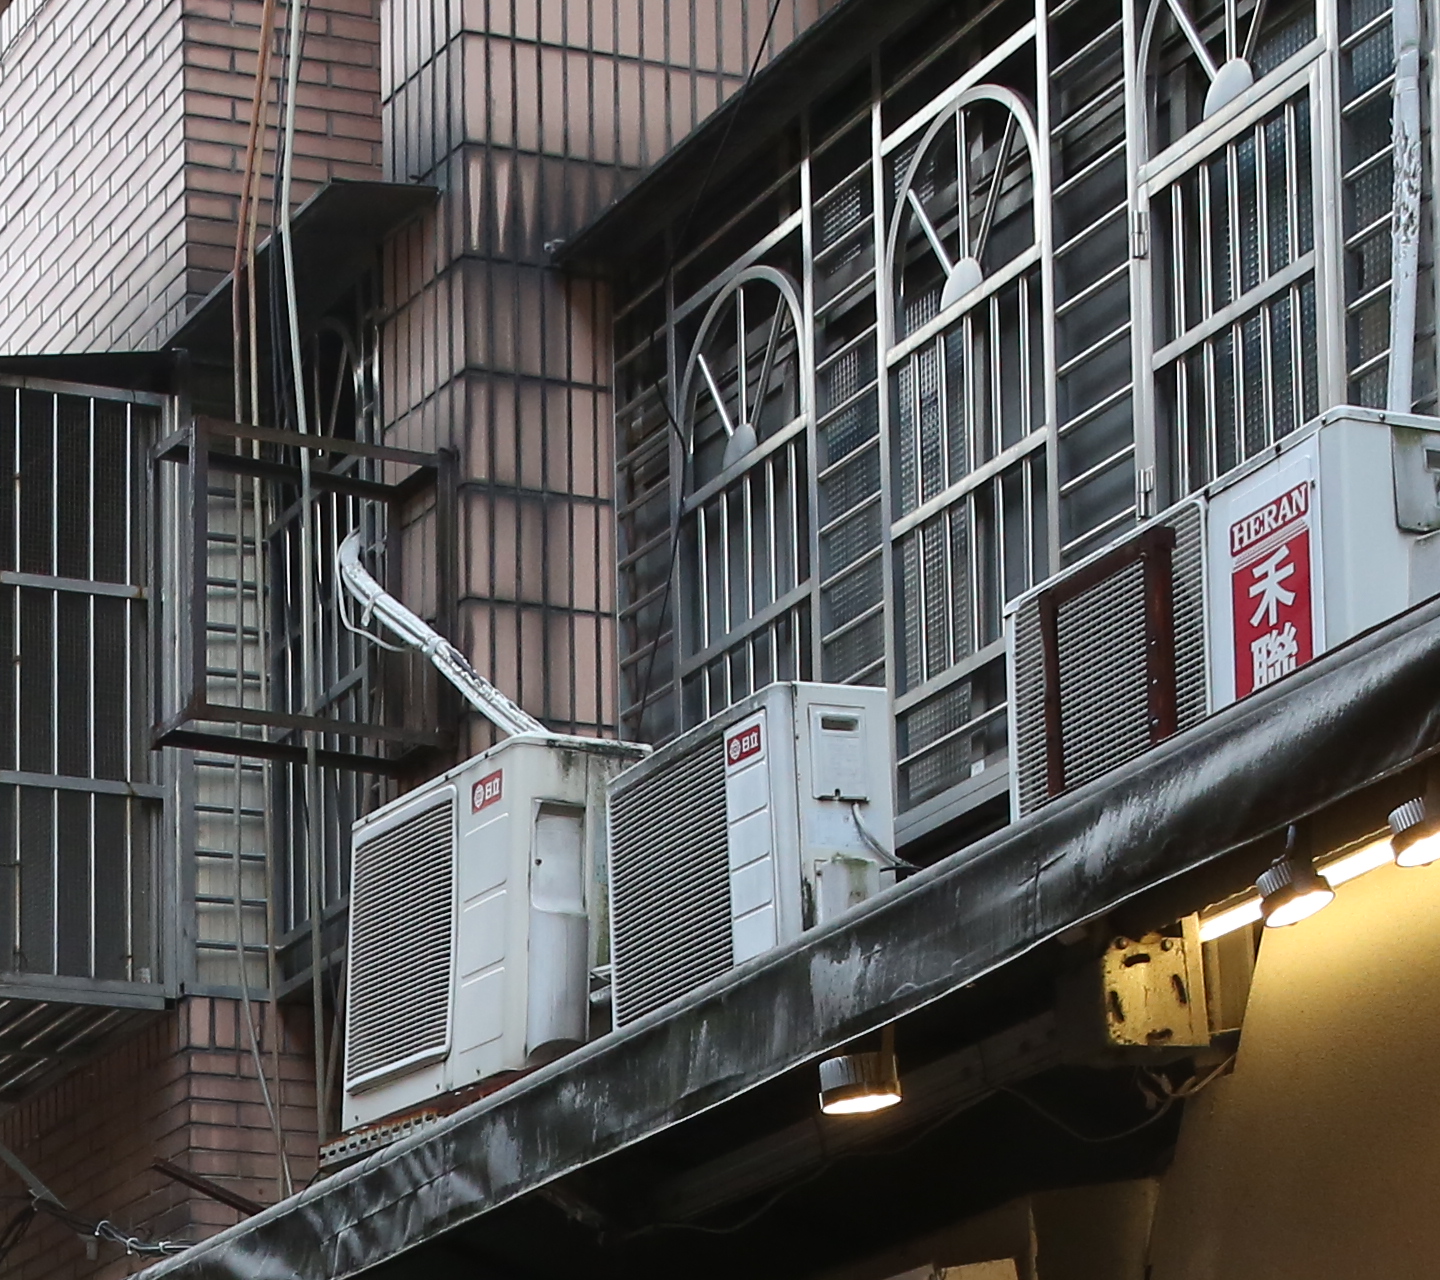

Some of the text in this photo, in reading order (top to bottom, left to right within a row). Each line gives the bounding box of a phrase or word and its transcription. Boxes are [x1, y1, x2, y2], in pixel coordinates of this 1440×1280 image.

[1231, 483, 1309, 553] HERAN
[742, 731, 759, 753] 日立
[484, 777, 501, 801] 日立
